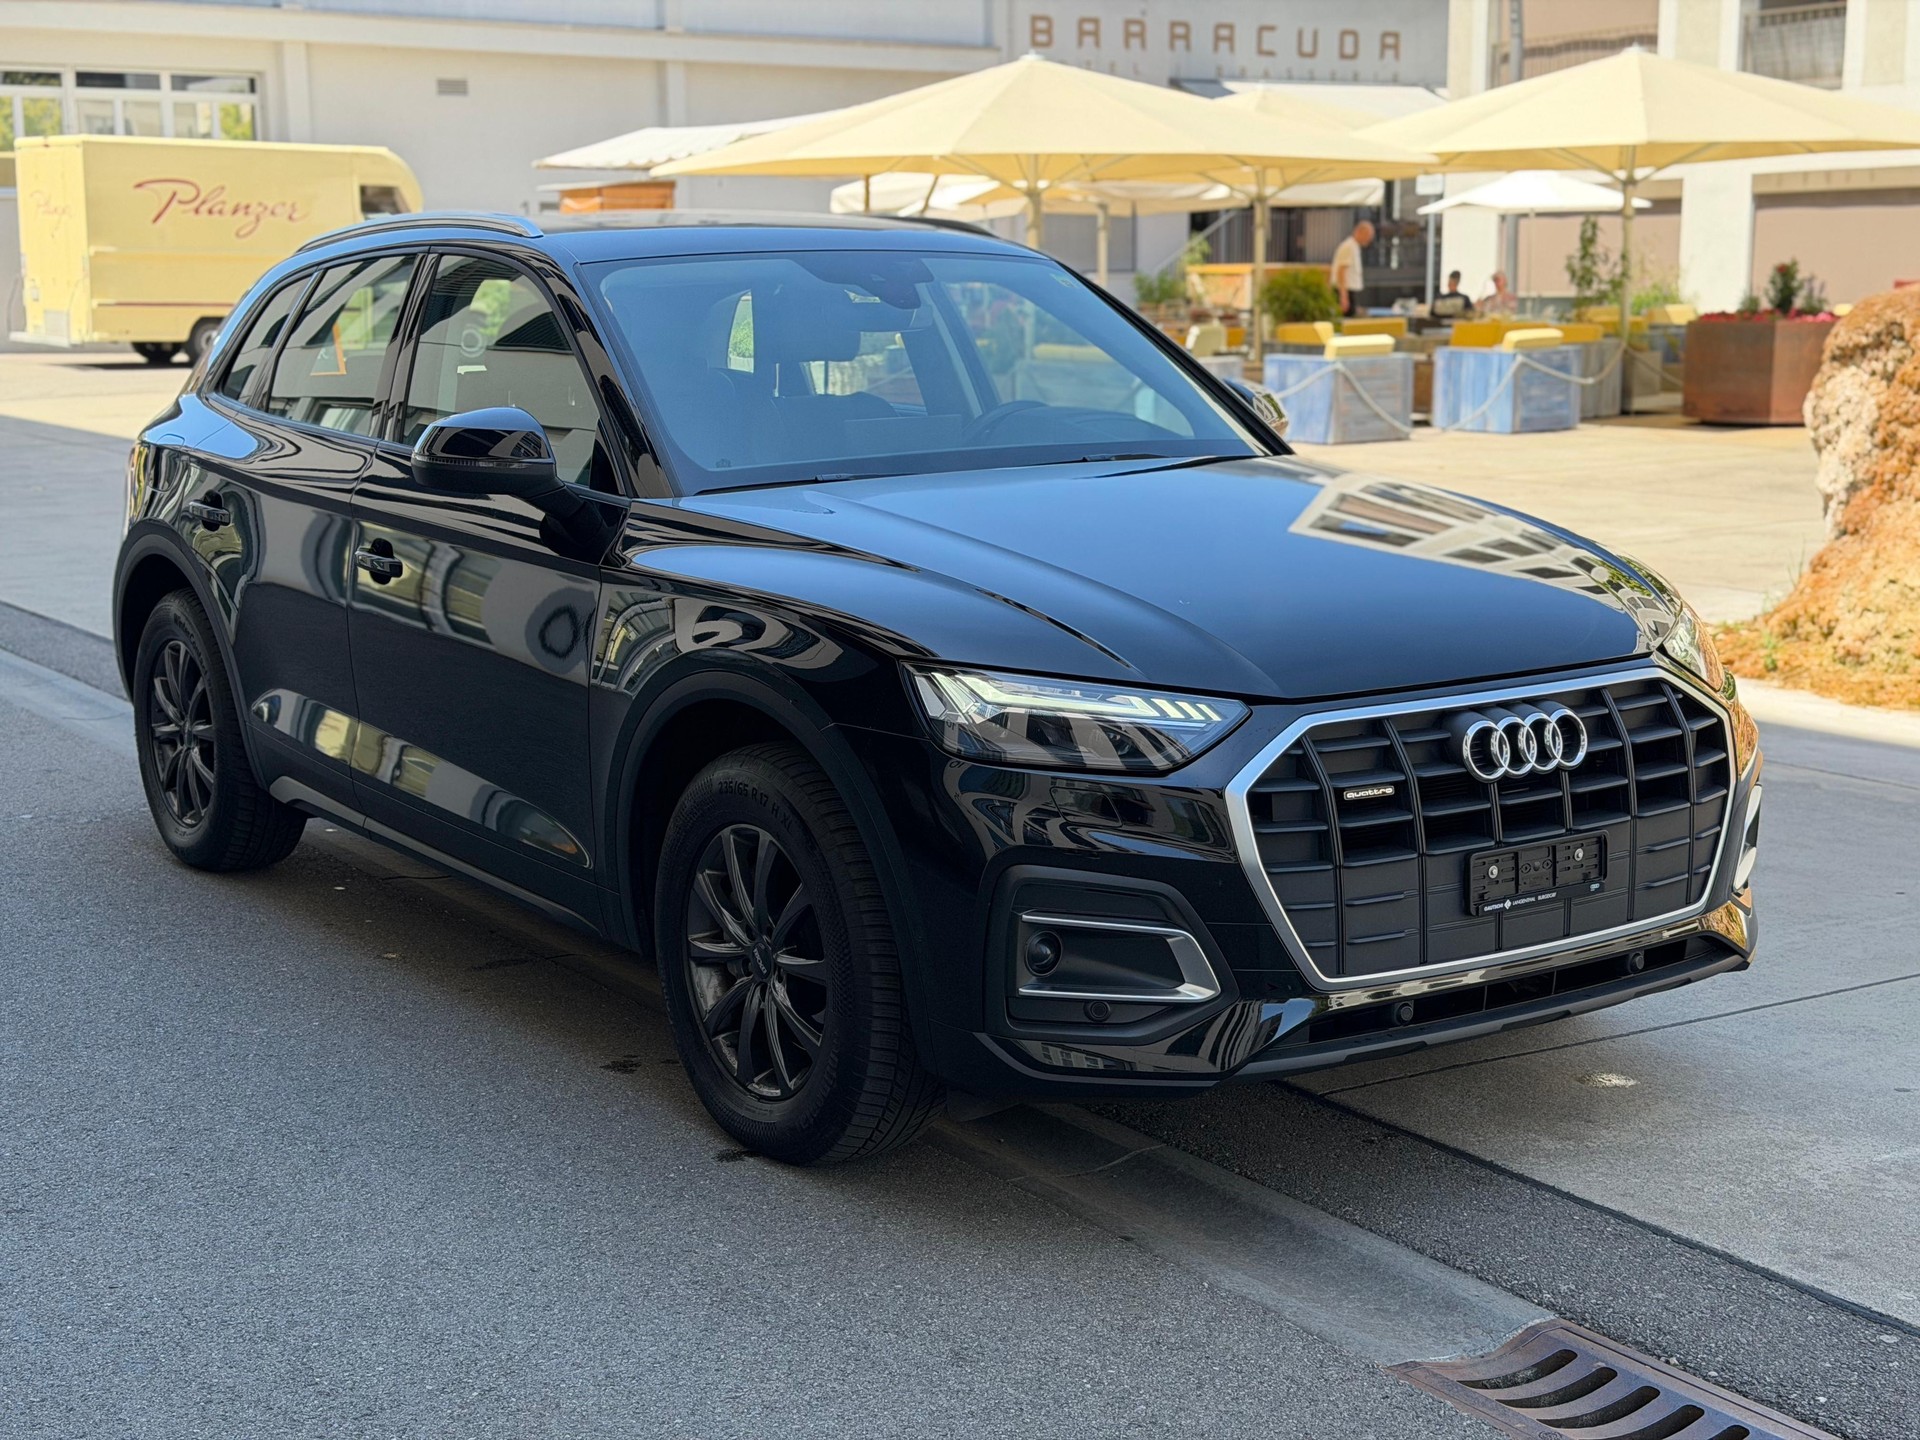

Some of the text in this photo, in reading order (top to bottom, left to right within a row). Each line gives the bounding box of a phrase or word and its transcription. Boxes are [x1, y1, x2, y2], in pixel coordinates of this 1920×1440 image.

[1030, 15, 1401, 61] BARRACUDA
[134, 179, 308, 239] Planzer
[718, 780, 749, 798] 235/65
[751, 787, 758, 802] R
[760, 792, 769, 808] 17
[771, 802, 780, 819] H
[1346, 787, 1393, 799] quattro
